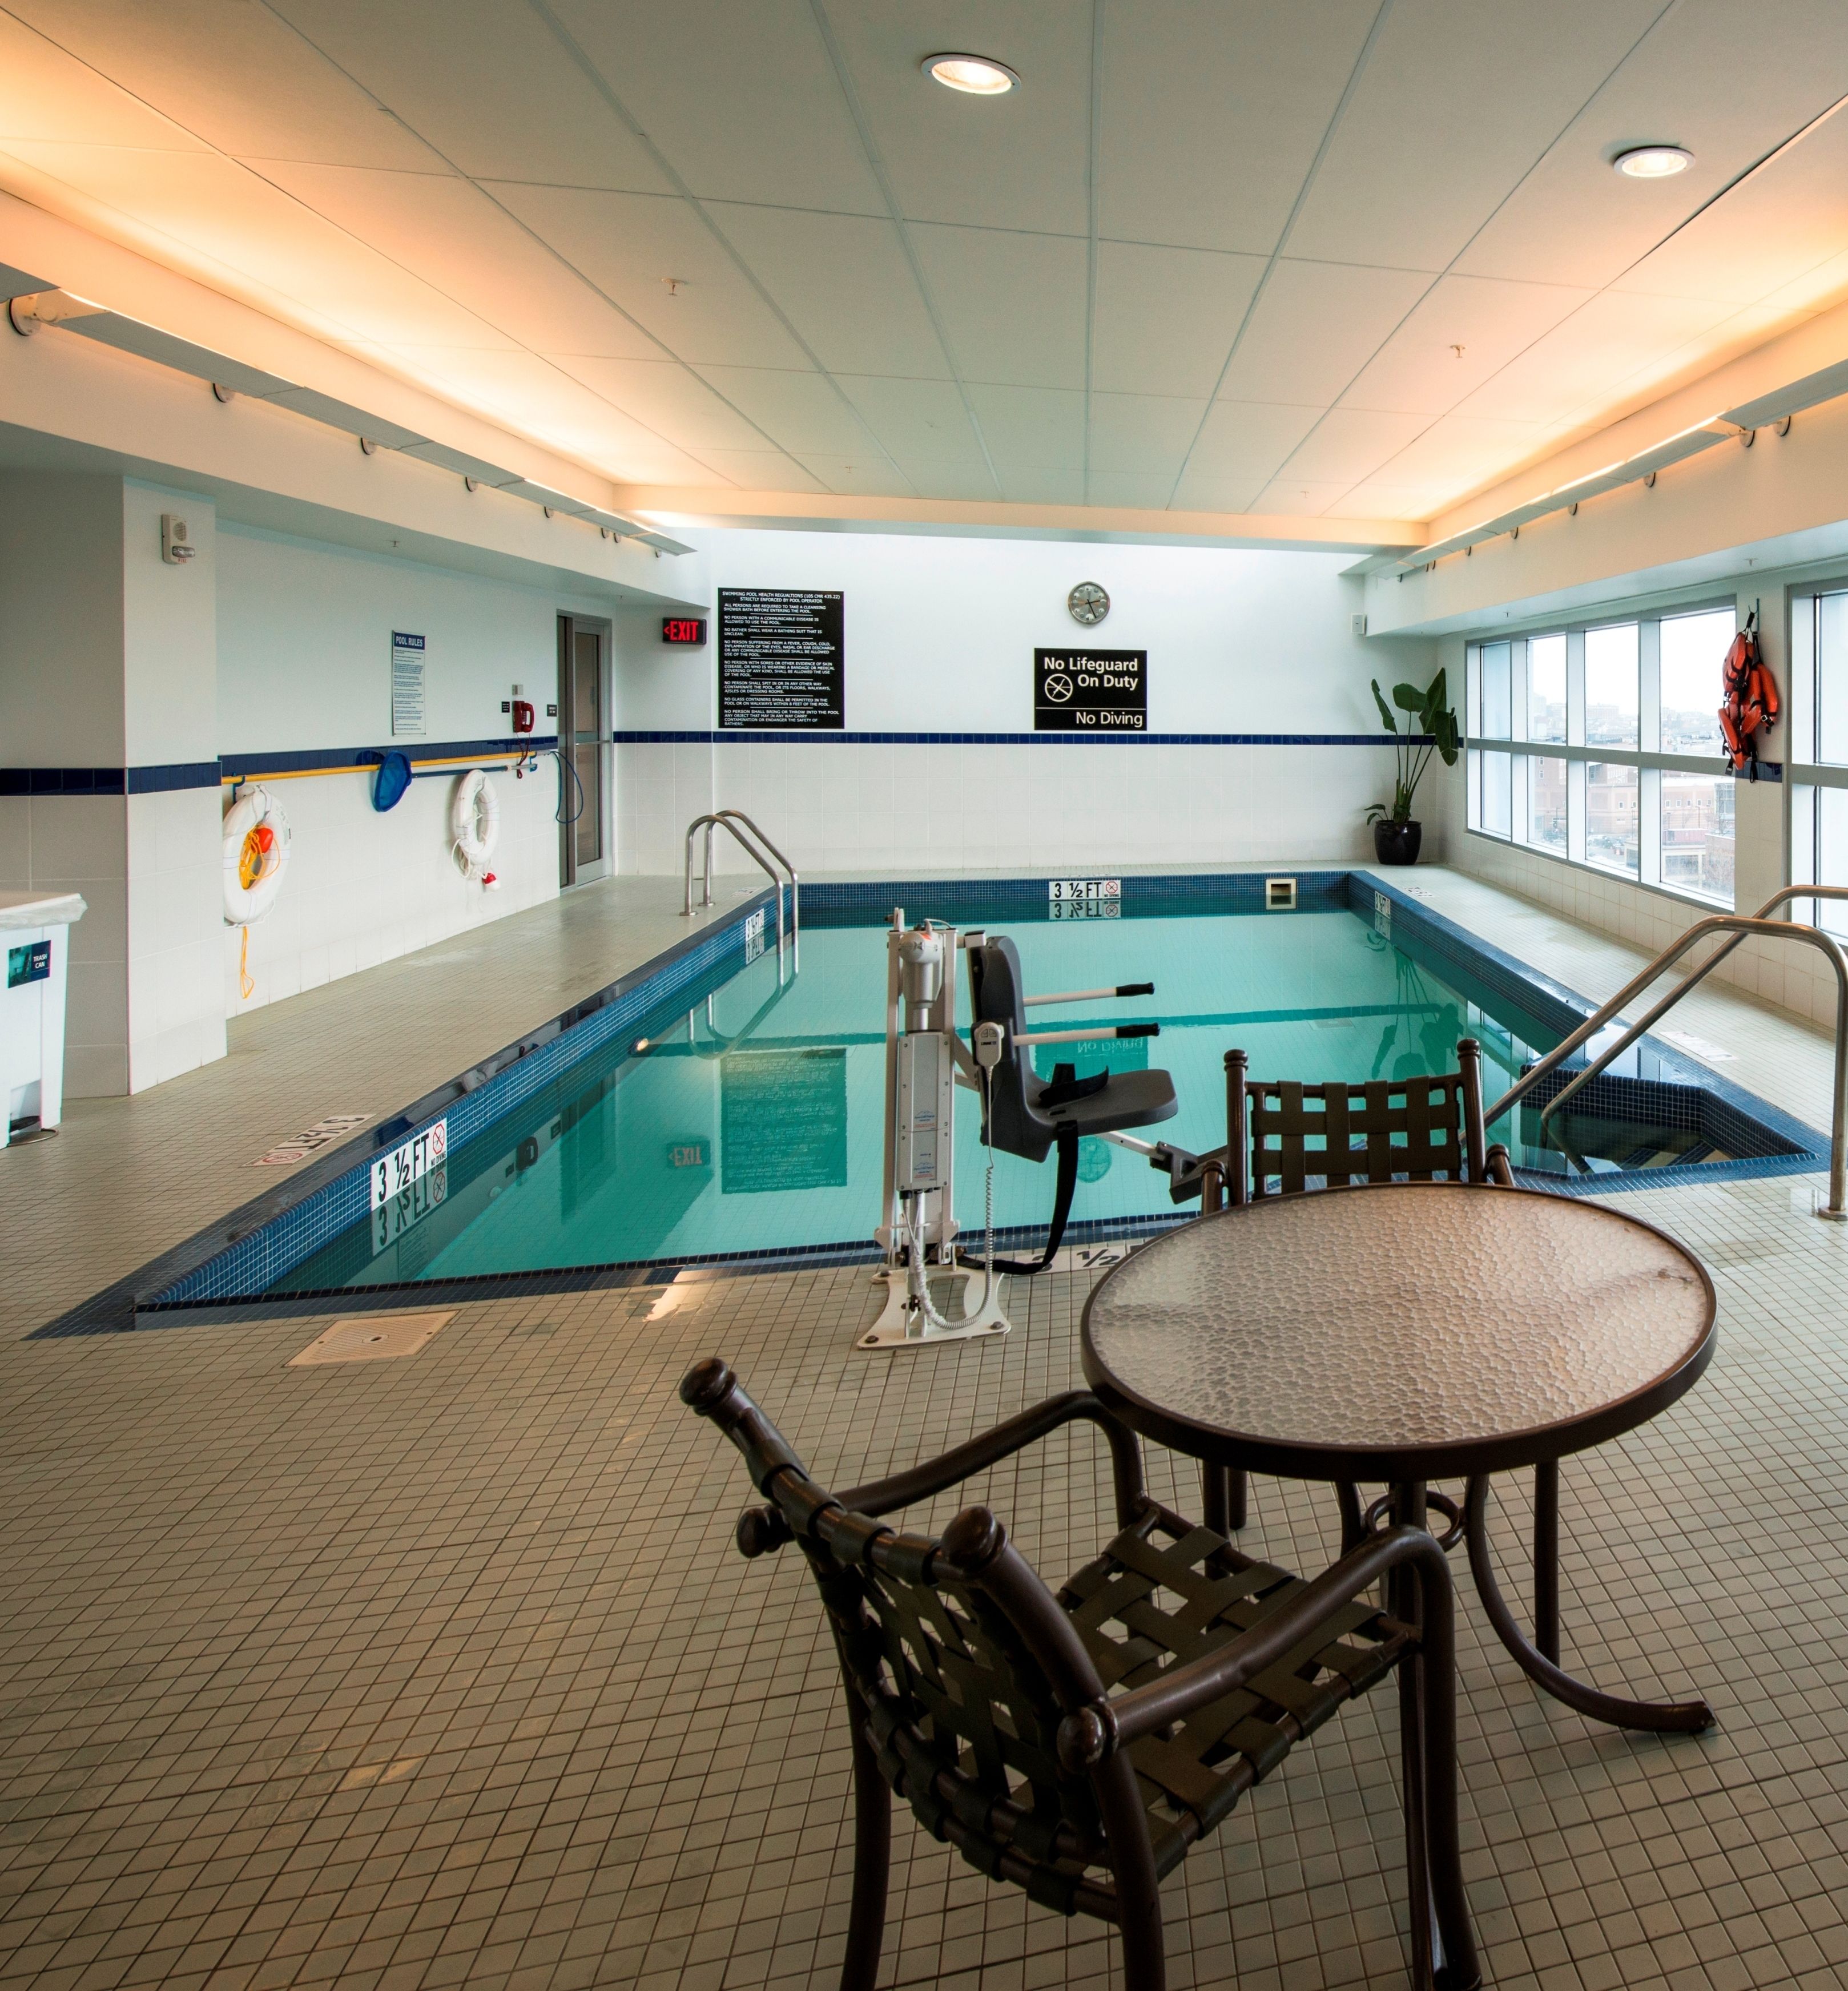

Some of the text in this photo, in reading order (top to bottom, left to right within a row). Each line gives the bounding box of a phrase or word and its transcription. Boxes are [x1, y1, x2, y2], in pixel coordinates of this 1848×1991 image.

[670, 620, 699, 641] EXIT
[396, 636, 423, 647] POOL RULES
[1044, 657, 1138, 674] No Lifeguard
[1077, 674, 1138, 691] On Duty
[1076, 712, 1143, 728] No Diving
[1054, 882, 1062, 898] 3
[1086, 882, 1102, 898] FT
[34, 954, 48, 962] TRASH
[379, 1161, 386, 1202] 3
[413, 1132, 429, 1180] FT
[431, 1151, 446, 1167] NO DIVING
